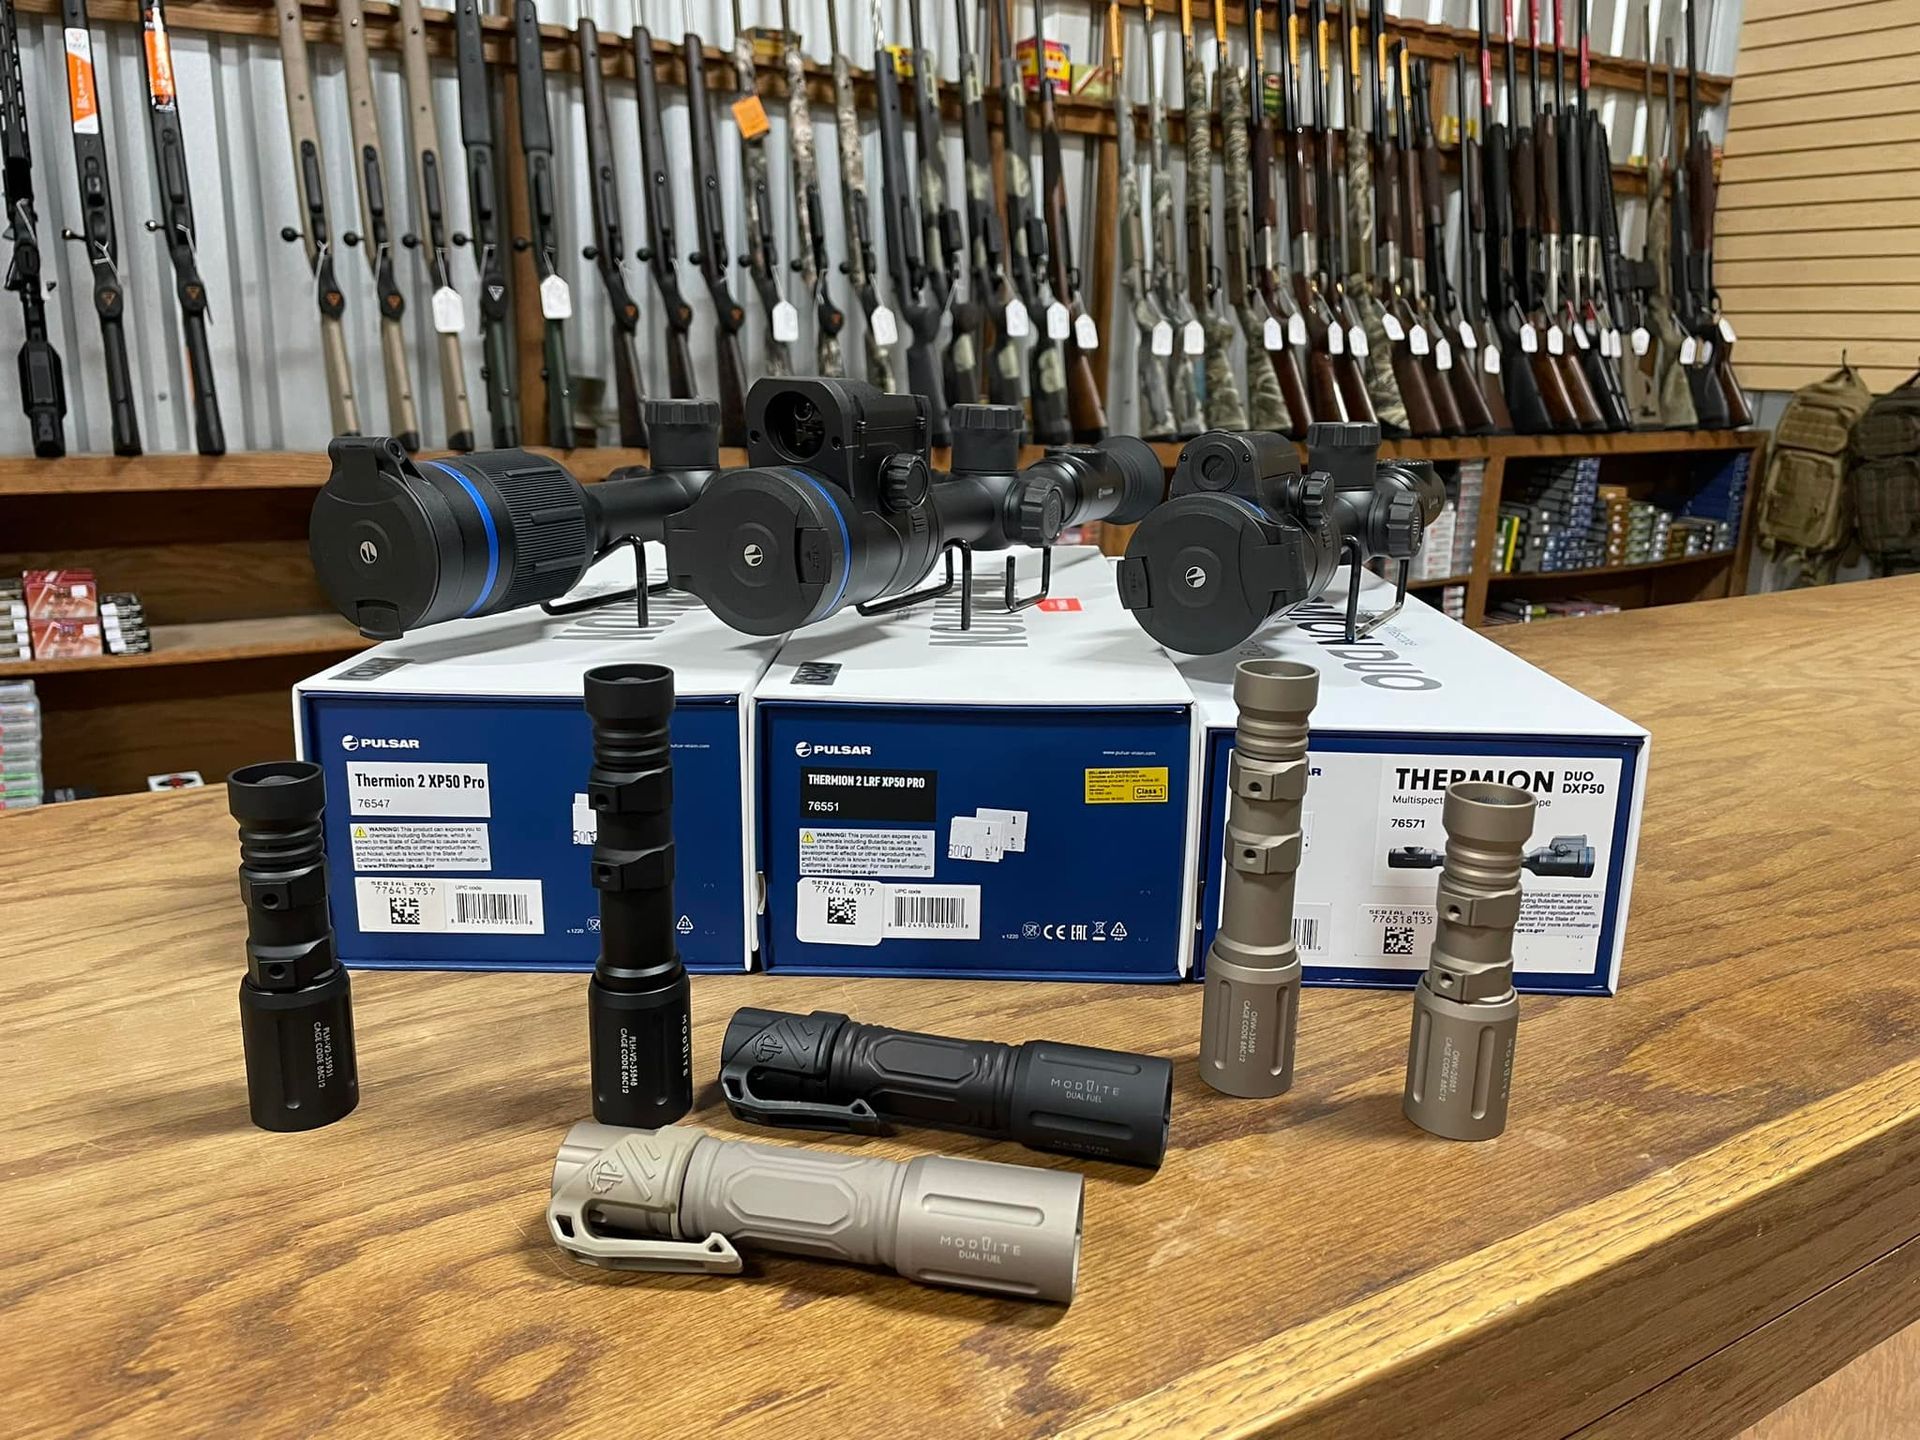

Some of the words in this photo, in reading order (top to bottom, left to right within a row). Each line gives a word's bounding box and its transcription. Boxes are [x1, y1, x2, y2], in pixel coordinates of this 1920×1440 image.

[1325, 649, 1442, 691] DUO
[361, 739, 419, 749] PULSAR
[814, 745, 872, 755] PULSAR
[354, 773, 415, 788] Thermion
[418, 774, 425, 788] 2
[429, 774, 460, 788] XP50
[464, 775, 485, 789] Pro
[808, 774, 854, 786] THERMION
[856, 776, 862, 786] 2
[863, 776, 880, 787] LRF
[882, 777, 905, 788] XP50
[907, 778, 925, 789] PRO
[1564, 771, 1594, 782] DUO
[1136, 787, 1157, 795] Class
[1562, 783, 1605, 794] DXP50
[358, 799, 390, 809] 76547
[808, 801, 839, 811] 76551
[1392, 795, 1444, 806] Multispect
[1391, 818, 1425, 828] 76571
[375, 886, 436, 895] 776415757
[815, 886, 875, 895] 776414917
[1373, 915, 1433, 924] 776518135
[1043, 924, 1066, 940] CE
[1243, 1000, 1251, 1019] CAGE
[313, 1021, 322, 1042] CAGE
[1241, 1020, 1249, 1040] CODE
[620, 1028, 628, 1048] CAGE
[315, 1043, 325, 1064] CODE
[621, 1049, 629, 1070] CODE
[1066, 1090, 1086, 1102] DUAL
[1086, 1093, 1102, 1104] FUEL
[959, 1249, 980, 1261] DUAL
[982, 1252, 1002, 1265] FUEL
